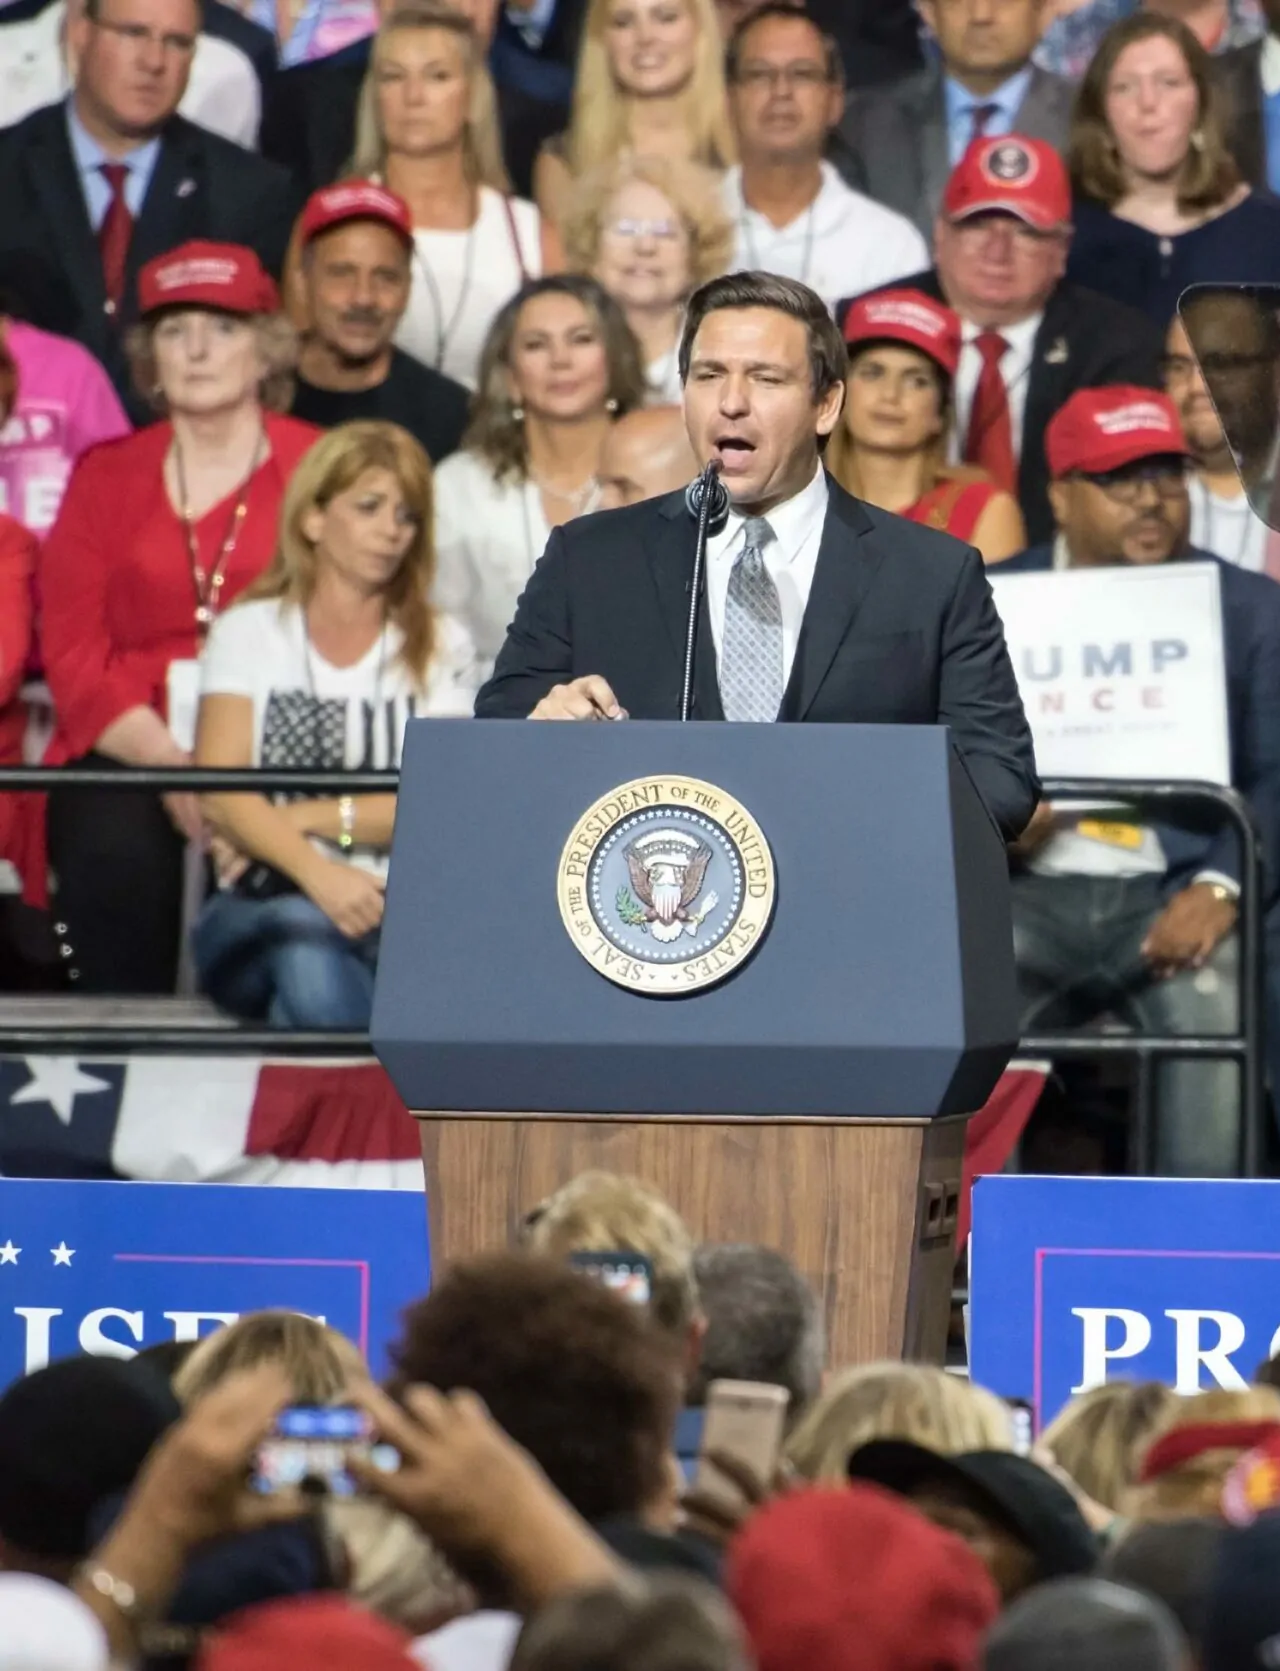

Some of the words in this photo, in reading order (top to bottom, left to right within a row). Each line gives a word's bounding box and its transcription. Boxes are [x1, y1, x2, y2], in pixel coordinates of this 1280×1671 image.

[670, 785, 690, 800] OF
[694, 790, 721, 813] THE
[566, 783, 665, 879] PRESIDENT
[724, 809, 768, 900] UNITED
[568, 886, 583, 915] THE
[575, 918, 592, 937] OF
[588, 935, 646, 982] SEAL
[682, 918, 757, 982] STATES
